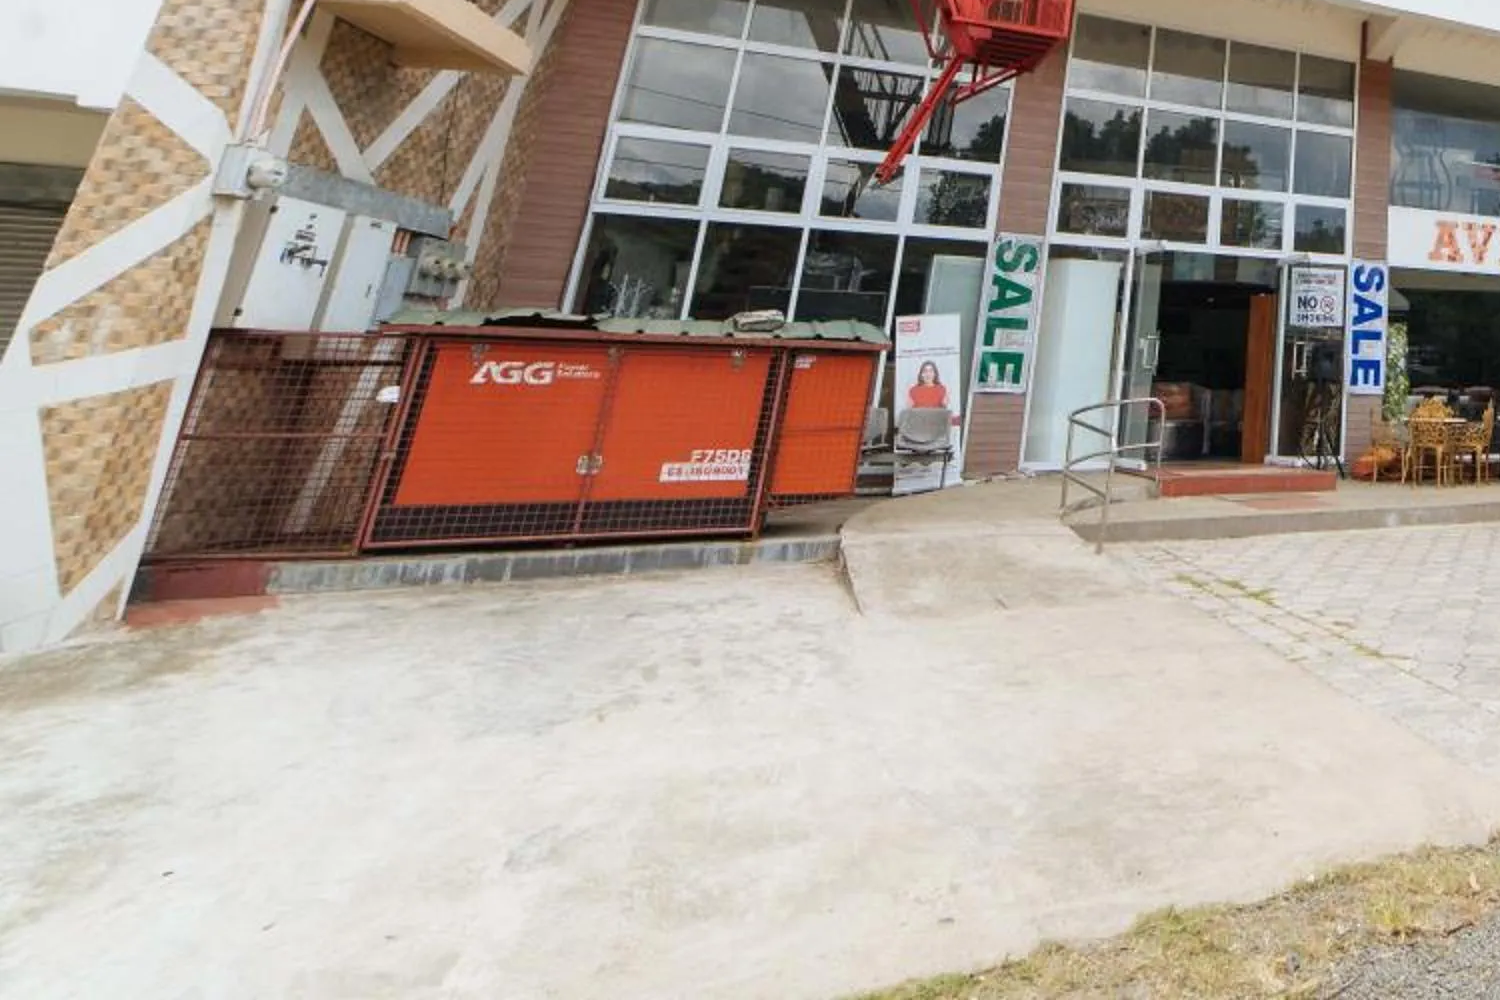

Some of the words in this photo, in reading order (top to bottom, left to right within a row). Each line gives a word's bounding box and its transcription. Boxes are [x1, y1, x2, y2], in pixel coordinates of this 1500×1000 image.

[978, 239, 1038, 384] SALE
[1297, 295, 1318, 309] NO
[1350, 264, 1385, 387] SALE
[470, 361, 556, 385] AGG
